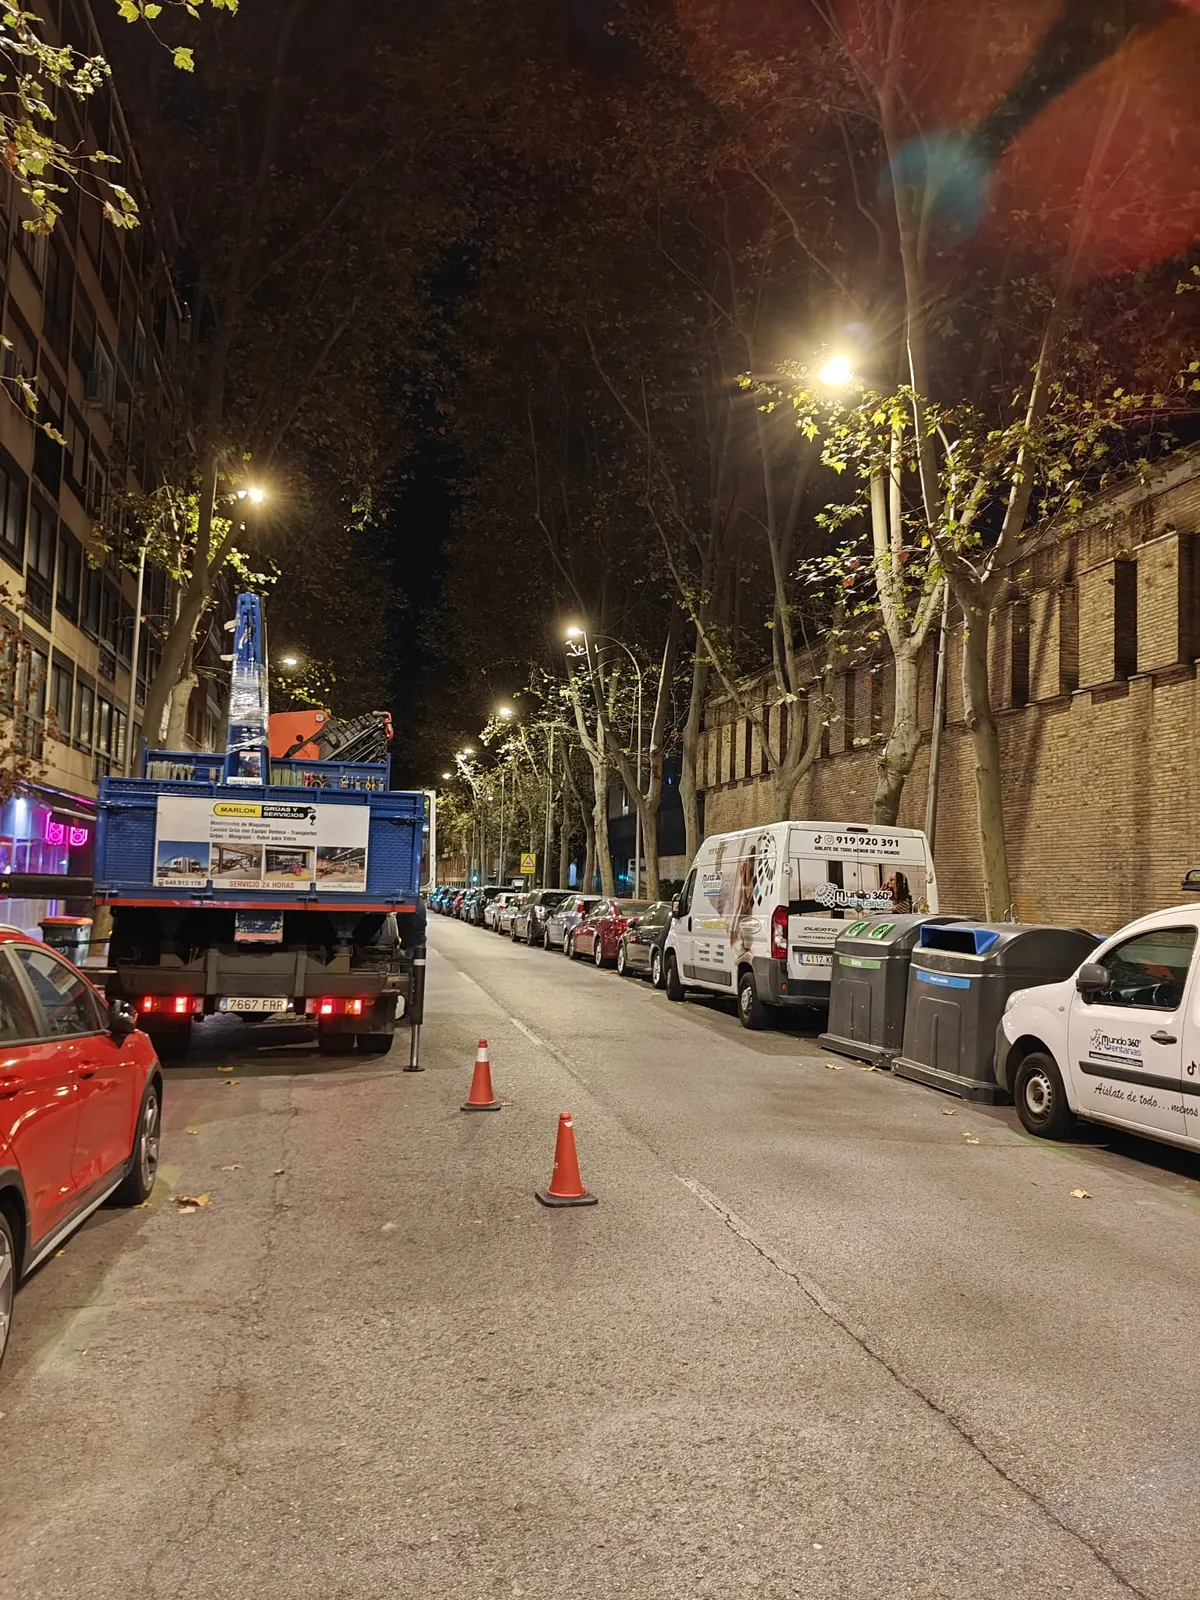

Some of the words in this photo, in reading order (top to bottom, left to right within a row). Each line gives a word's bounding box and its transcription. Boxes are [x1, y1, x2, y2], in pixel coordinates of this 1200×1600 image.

[220, 806, 256, 814] MARLON
[836, 836, 856, 845] 919
[858, 837, 878, 846] 920
[880, 839, 899, 847] 391
[229, 880, 260, 888] SERVICIO
[261, 880, 270, 888] 24
[272, 881, 295, 889] HORAS
[835, 890, 871, 901] Muno
[805, 955, 823, 964] 4117
[229, 999, 259, 1010] 7667
[1094, 1082, 1125, 1100] Aislate
[1127, 1091, 1138, 1103] de
